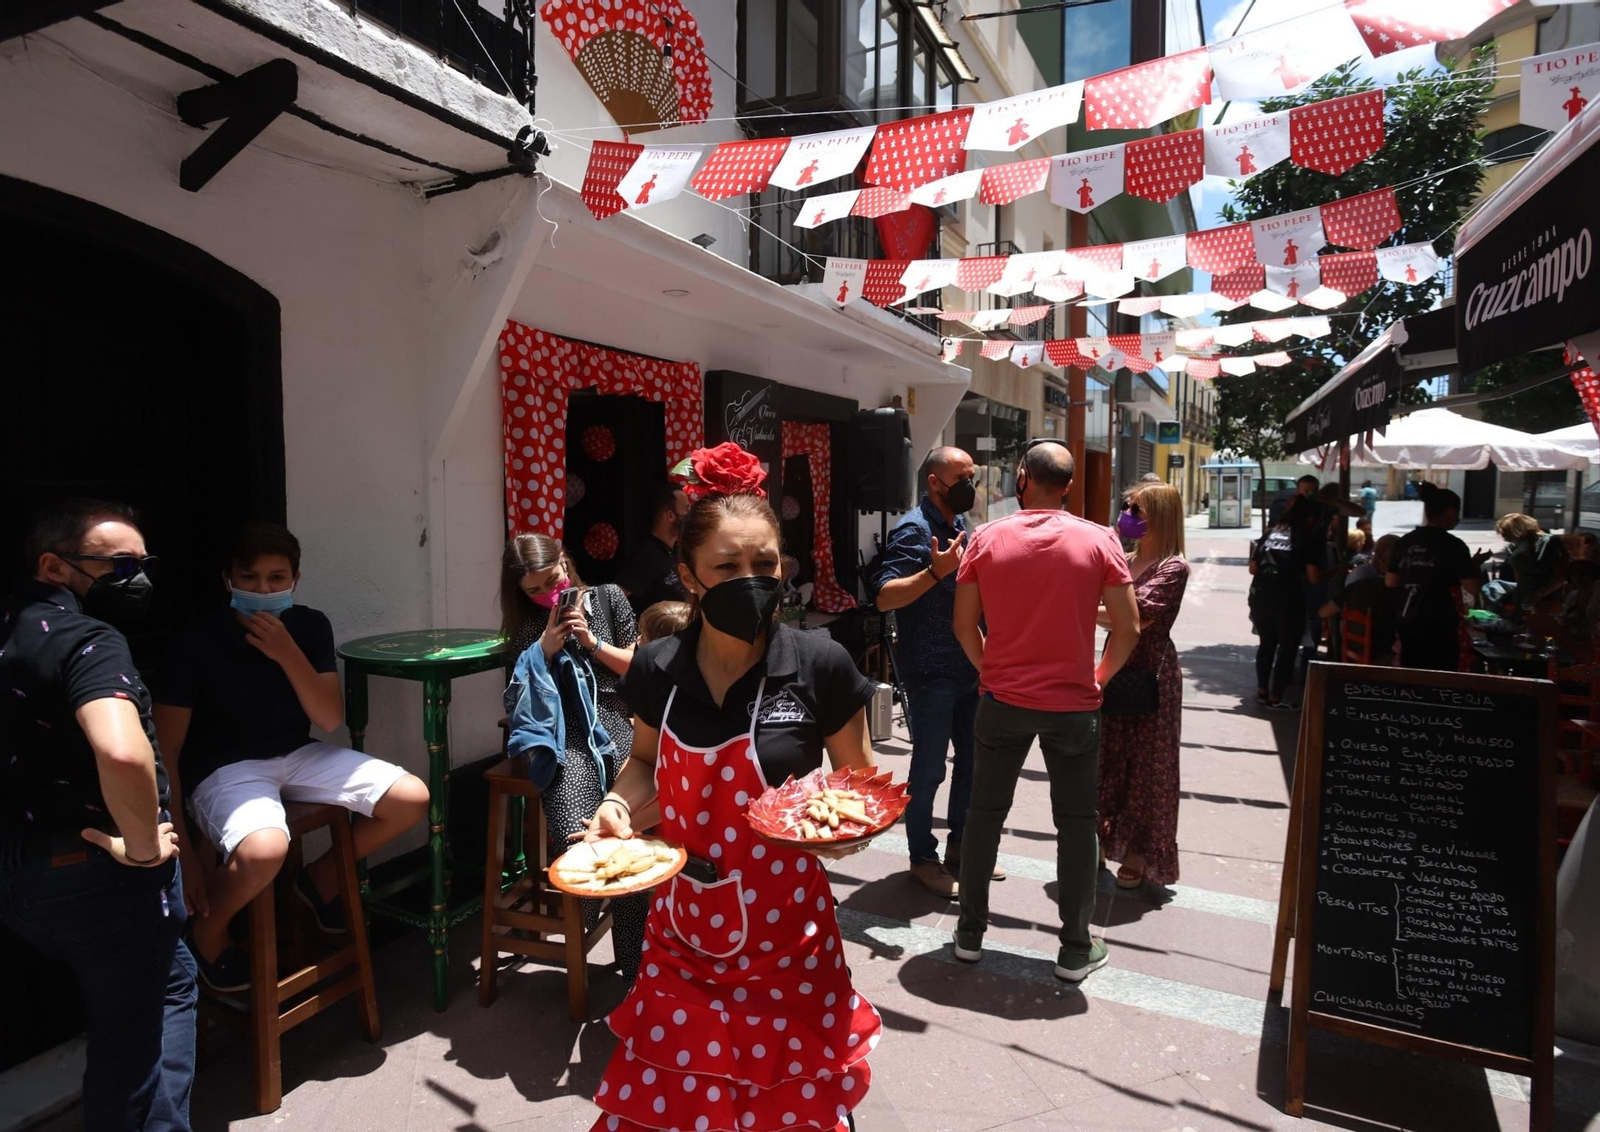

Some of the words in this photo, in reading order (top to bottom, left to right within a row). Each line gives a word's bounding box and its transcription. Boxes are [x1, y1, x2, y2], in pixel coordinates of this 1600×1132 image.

[1534, 58, 1567, 74] TIO
[988, 103, 1017, 115] TIO
[1024, 91, 1069, 106] PEPE
[1214, 126, 1239, 137] TIO
[1244, 117, 1280, 131] PEPE
[798, 140, 823, 150] TIO
[827, 136, 863, 147] PEPE
[647, 151, 666, 160] TIO
[666, 151, 694, 160] PEPE
[1060, 157, 1081, 168] TIO
[1085, 151, 1116, 163] PEPE
[1260, 221, 1280, 232] TIO
[1284, 214, 1314, 227] PEPE
[1131, 244, 1149, 252] TIO
[1153, 240, 1178, 249] PEPE
[1383, 250, 1400, 258] TIO
[1402, 247, 1425, 255] PEPE
[848, 262, 862, 270] PEPE
[1502, 246, 1527, 273] DESDE
[1464, 227, 1592, 331] Cruzcampo
[1344, 684, 1423, 700] ESPECIAL
[1432, 689, 1495, 707] FERIA
[1346, 707, 1463, 728] ENSALADILLAS
[1454, 734, 1514, 748] MARISCO
[1341, 739, 1388, 752] QUESO
[1402, 747, 1515, 768] EMBORRIZADO
[1342, 755, 1390, 768] JAMÓN
[1398, 762, 1468, 778] IBÉRICO
[1333, 769, 1391, 784] TOMATE
[1400, 776, 1464, 791] ALIÑADO
[1332, 785, 1399, 802] TORTILLA
[1410, 792, 1465, 805] NORMAL
[1333, 803, 1399, 822] PIMIENTOS
[1403, 812, 1458, 829] FRITOS
[1409, 802, 1465, 815] CAMPERA
[1335, 821, 1418, 840] SALMOREJO
[1332, 833, 1413, 851] BOQUERONES
[1421, 844, 1441, 854] EN
[1446, 842, 1498, 860] VINAGRE
[1330, 848, 1408, 866] TORTILLITAS
[1414, 855, 1478, 874] BACALAO
[1332, 863, 1405, 880] CROQUETAS
[1412, 871, 1478, 889] VARIADAS
[1317, 890, 1389, 916] PESCAITOS
[1405, 896, 1454, 910] CHOCOS
[1459, 901, 1509, 917] FRITOS
[1450, 890, 1466, 901] EN
[1470, 892, 1505, 902] ADOBO
[1406, 906, 1482, 924] ORTIGUITAS
[1406, 915, 1456, 932] ROSADA
[1461, 924, 1476, 934] AL
[1480, 922, 1516, 937] LIMÓN
[1404, 927, 1477, 946] BOQUERONES
[1480, 937, 1519, 952] FRITOS
[1317, 943, 1388, 964] MONTADITOS
[1407, 952, 1474, 969] SERRANITO
[1406, 963, 1455, 977] SALMÓN
[1470, 973, 1506, 985] QUESO
[1405, 975, 1441, 986] QUESO
[1447, 982, 1501, 997] ANCHOAS
[1406, 987, 1470, 1004] VIOLINISTA
[1313, 990, 1425, 1020] CHICHARRONES
[1418, 998, 1450, 1009] POLLO
